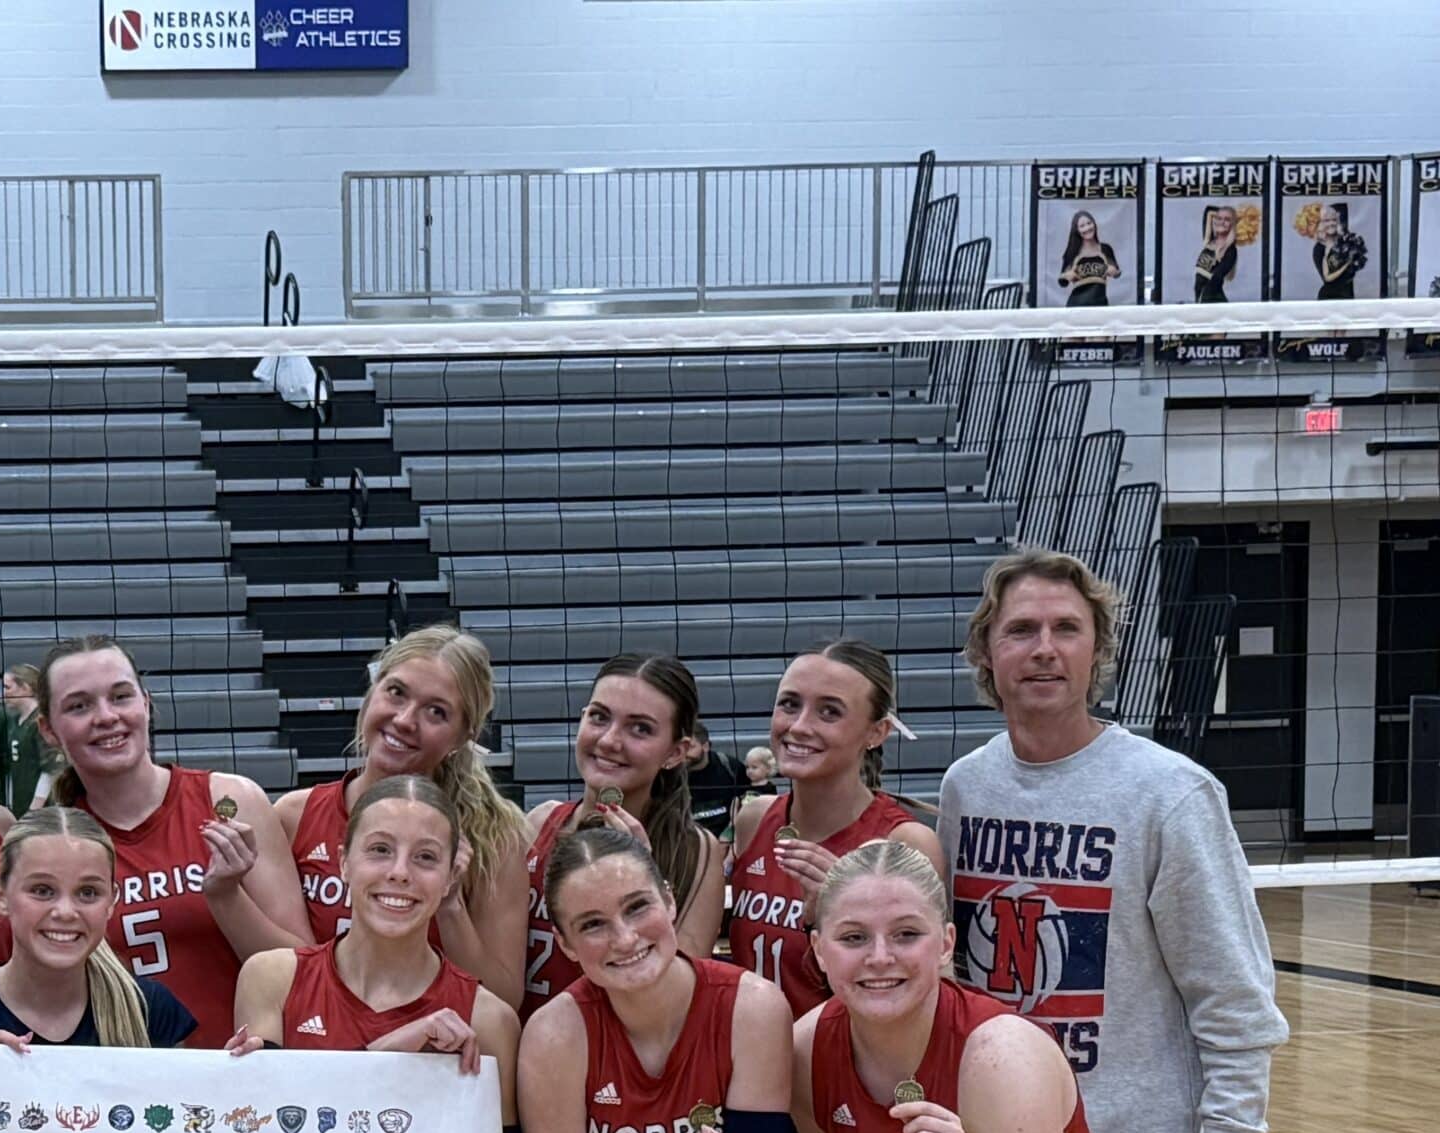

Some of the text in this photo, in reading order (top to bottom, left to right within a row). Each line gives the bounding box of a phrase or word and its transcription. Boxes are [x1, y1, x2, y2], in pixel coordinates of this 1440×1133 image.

[154, 11, 251, 27] NEBRASKA
[290, 8, 354, 25] CHEER
[154, 33, 251, 49] CROSSING
[295, 30, 401, 47] ATHLETICS
[1038, 166, 1138, 187] GRIFFIN
[1162, 164, 1264, 185] GRIFFIN
[1282, 163, 1383, 184] GRIFFIN
[1038, 186, 1138, 199] CHEER
[1162, 184, 1264, 197] CHEER
[1282, 183, 1383, 196] CHEER
[1177, 345, 1241, 359] PAULSEN
[1307, 344, 1349, 357] WOLF
[956, 816, 1117, 882] NORRIS
[114, 863, 204, 904] RRIS
[732, 889, 805, 931] NORR
[122, 909, 169, 976] 5
[987, 895, 1046, 996] N
[753, 933, 783, 987] 11
